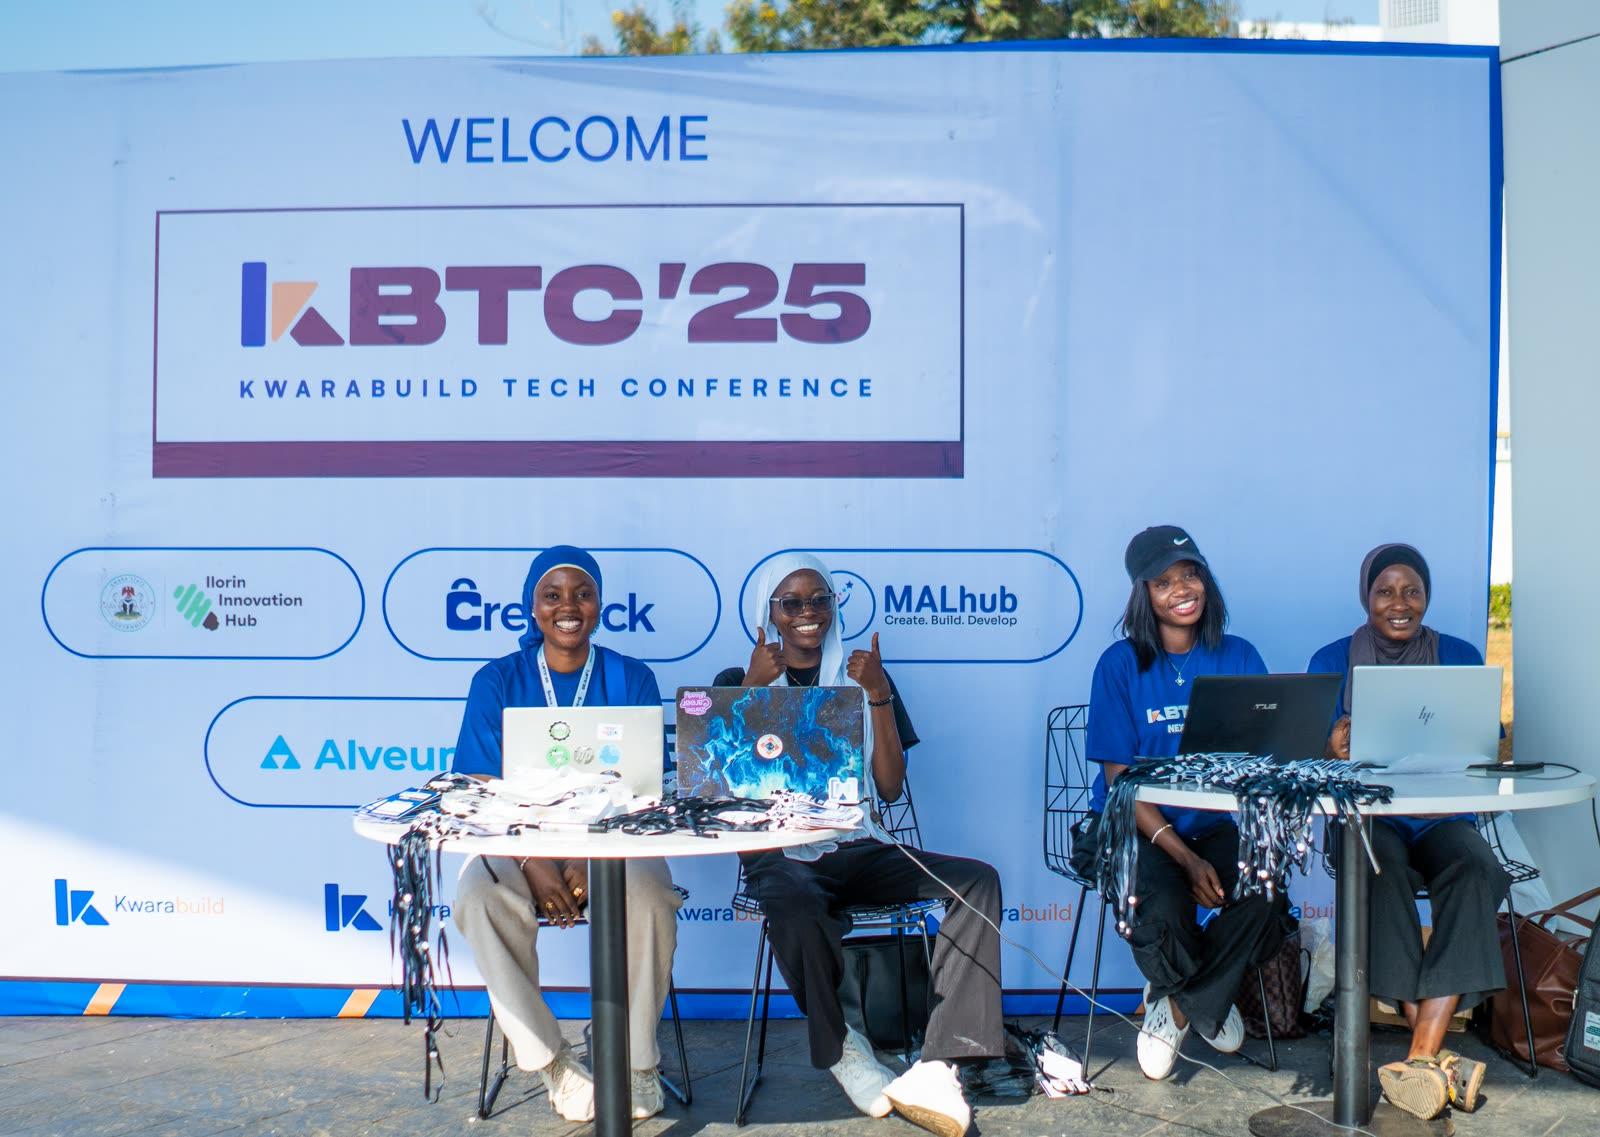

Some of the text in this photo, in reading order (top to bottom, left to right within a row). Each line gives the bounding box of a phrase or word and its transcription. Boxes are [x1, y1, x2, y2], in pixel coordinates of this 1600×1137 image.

[401, 115, 709, 164] WELCOME
[240, 378, 873, 398] KWARABUILD TECH CONFERENCE
[206, 575, 246, 589] Ilorin
[219, 593, 303, 607] Innovation
[884, 585, 1018, 613] MALhub
[226, 614, 258, 627] Hub
[884, 615, 1018, 627] Create. Build. Develop
[115, 896, 224, 914] Kwarabuild
